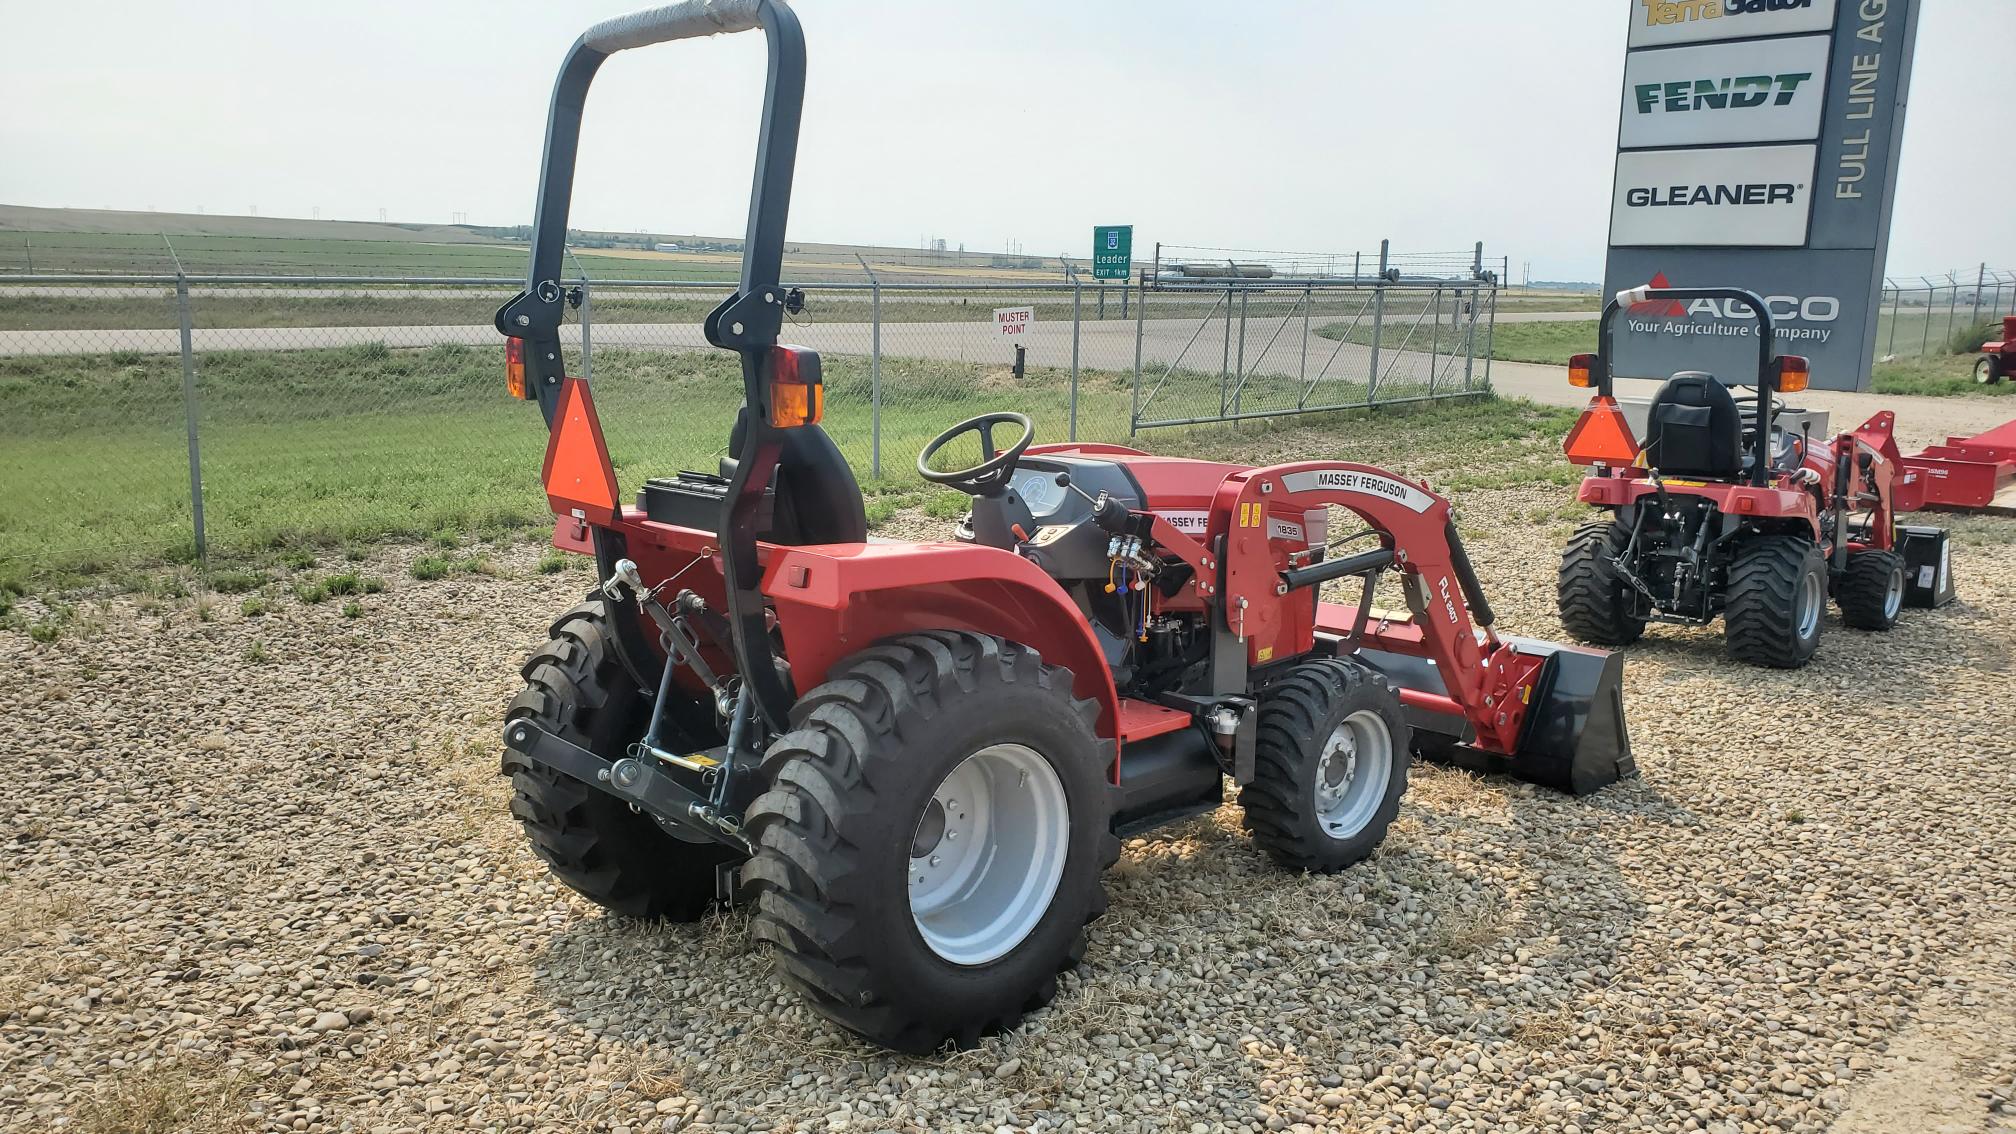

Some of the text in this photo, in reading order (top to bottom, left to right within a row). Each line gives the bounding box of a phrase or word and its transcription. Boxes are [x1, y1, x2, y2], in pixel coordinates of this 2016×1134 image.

[1846, 53, 1880, 119] LINE
[1634, 72, 1812, 114] FENDT
[1835, 129, 1870, 199] FULL
[1096, 254, 1128, 264] Leader
[1096, 268, 1109, 276] EXIT
[998, 311, 1030, 323] MUSTER
[1002, 323, 1026, 335] POINT
[1628, 319, 1660, 333] Your
[1663, 320, 1749, 338] Agriculture
[1318, 473, 1408, 500] MASSEY FERGUSON
[1164, 517, 1195, 527] ASSEY
[1278, 524, 1298, 536] 1835
